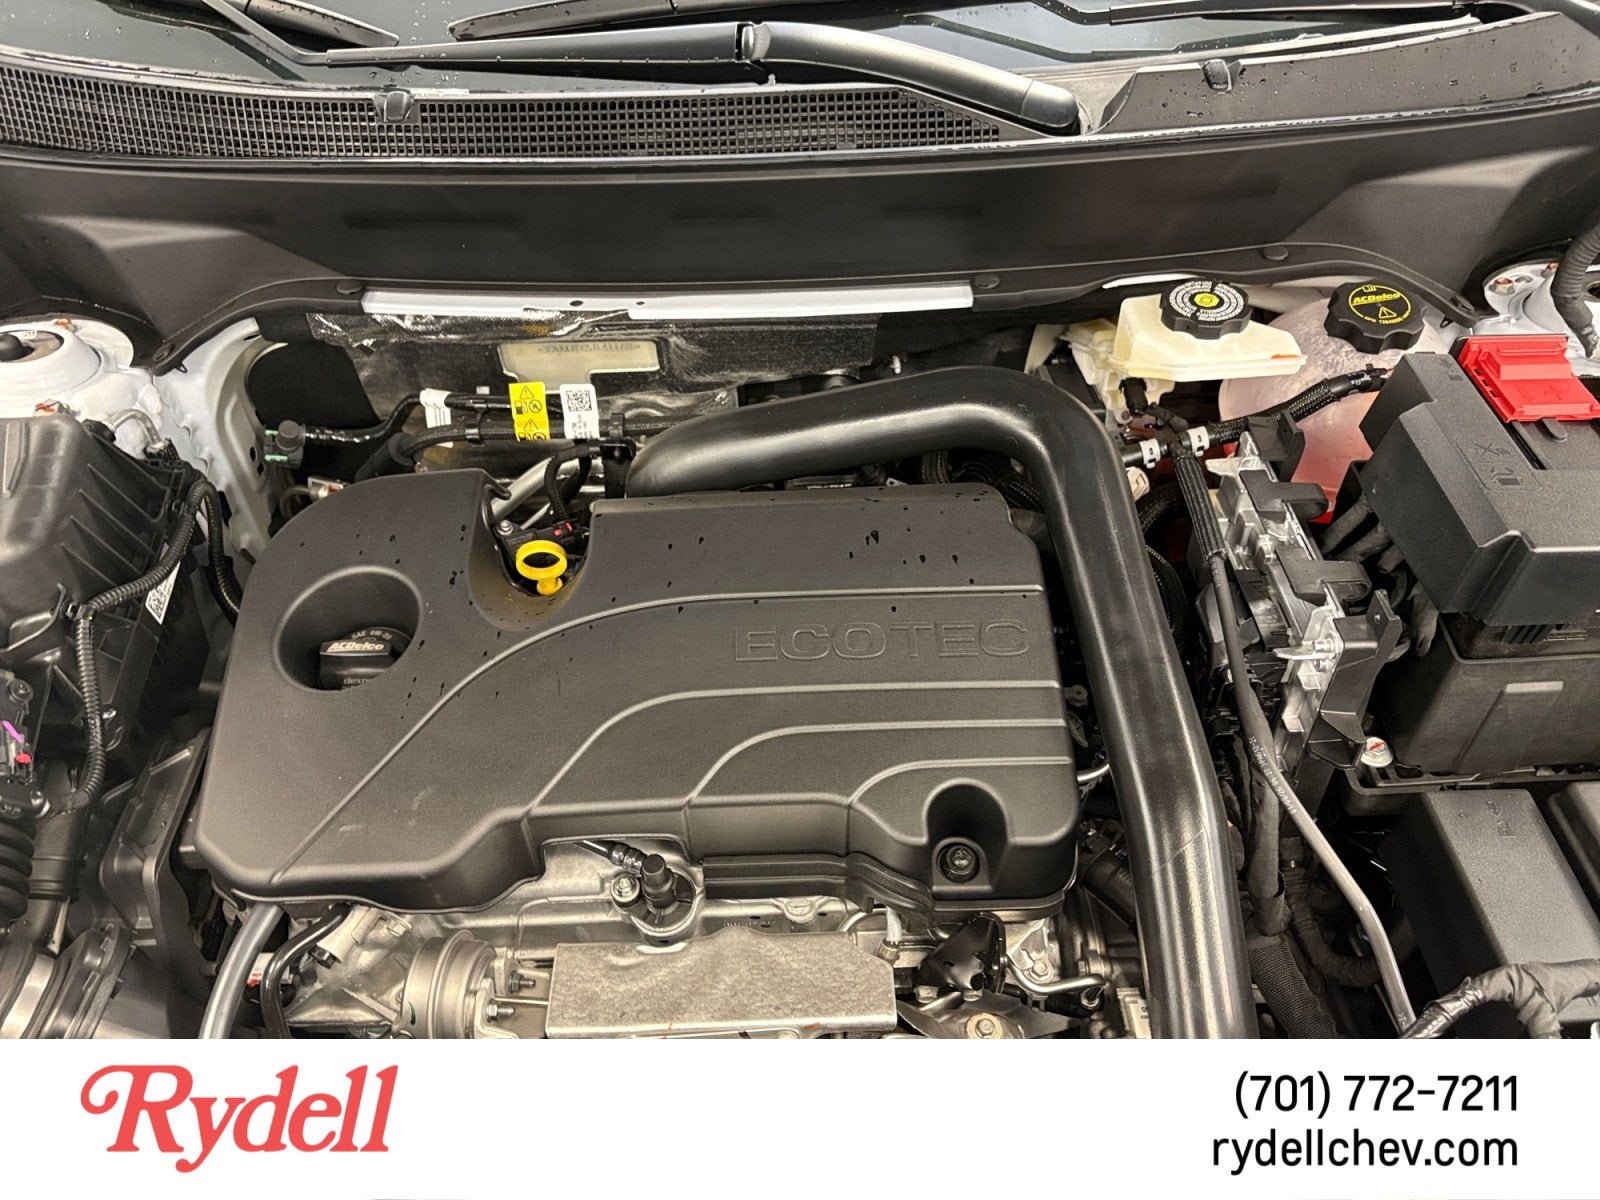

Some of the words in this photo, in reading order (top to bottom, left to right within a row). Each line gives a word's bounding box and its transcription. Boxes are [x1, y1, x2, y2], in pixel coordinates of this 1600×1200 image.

[1352, 293, 1400, 306] ACDelco
[352, 630, 366, 639] SAE
[735, 619, 1030, 662] ECOTEC
[327, 641, 384, 653] ACDelco
